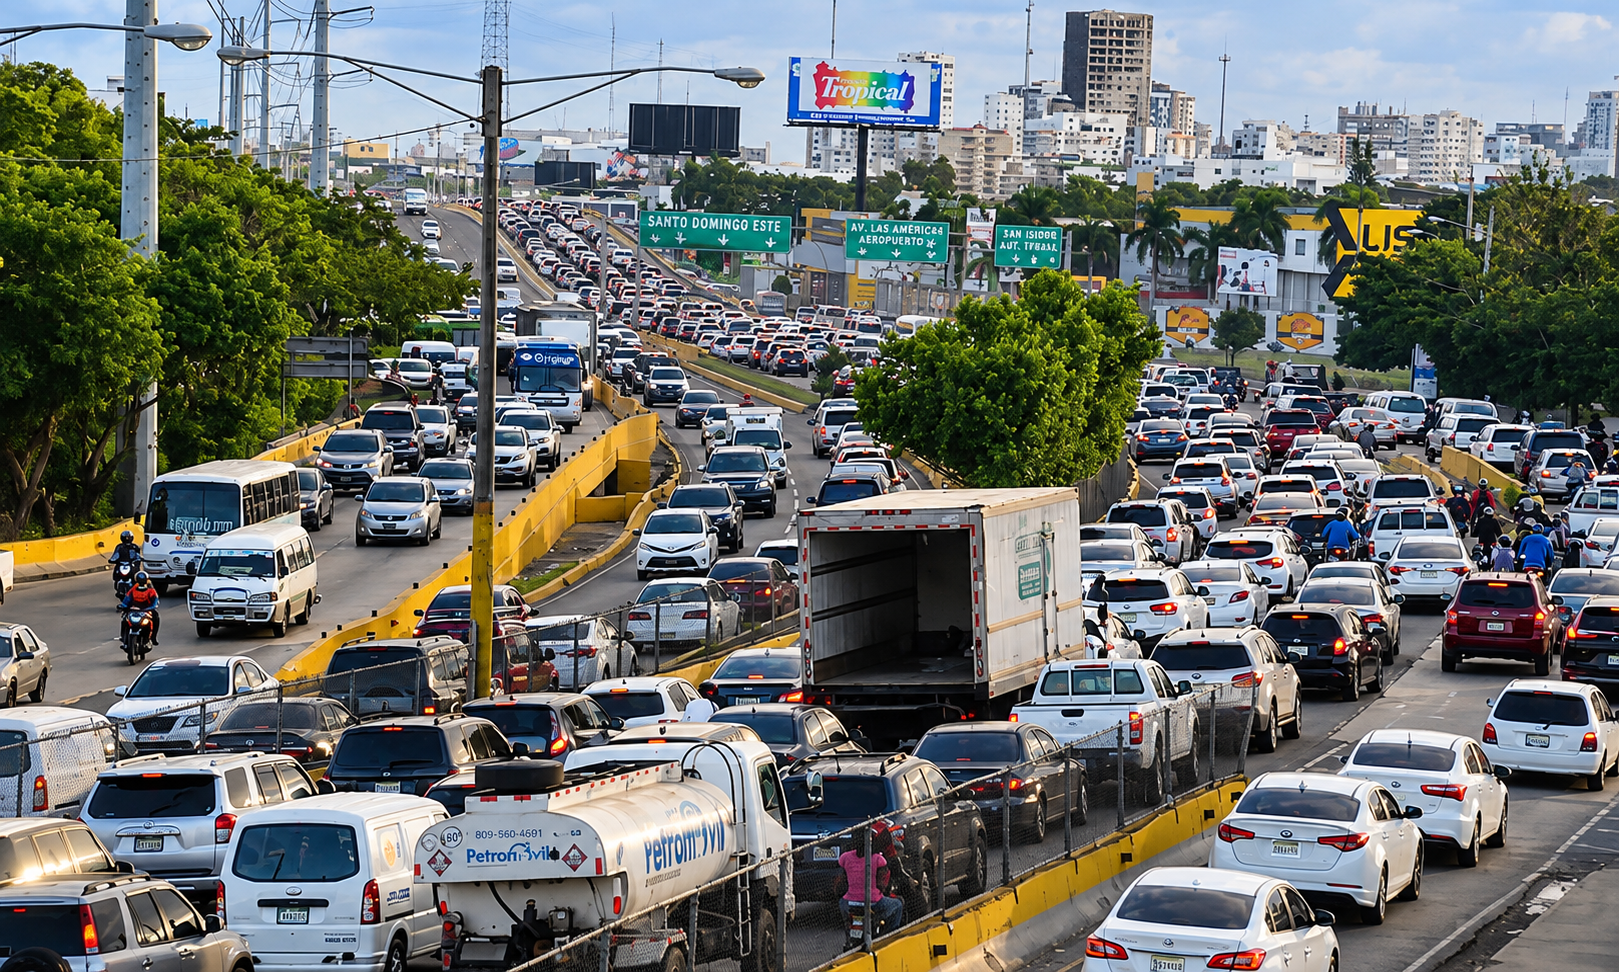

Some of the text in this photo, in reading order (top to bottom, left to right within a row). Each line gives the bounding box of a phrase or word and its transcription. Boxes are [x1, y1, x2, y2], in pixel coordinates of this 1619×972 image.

[821, 76, 909, 105] Tropical
[648, 216, 781, 233] SANTO DOMINGO ESTE
[851, 223, 868, 232] AV.
[871, 224, 889, 233] LAS
[1003, 229, 1022, 239] SAN
[858, 235, 924, 246] AEROPUERTO
